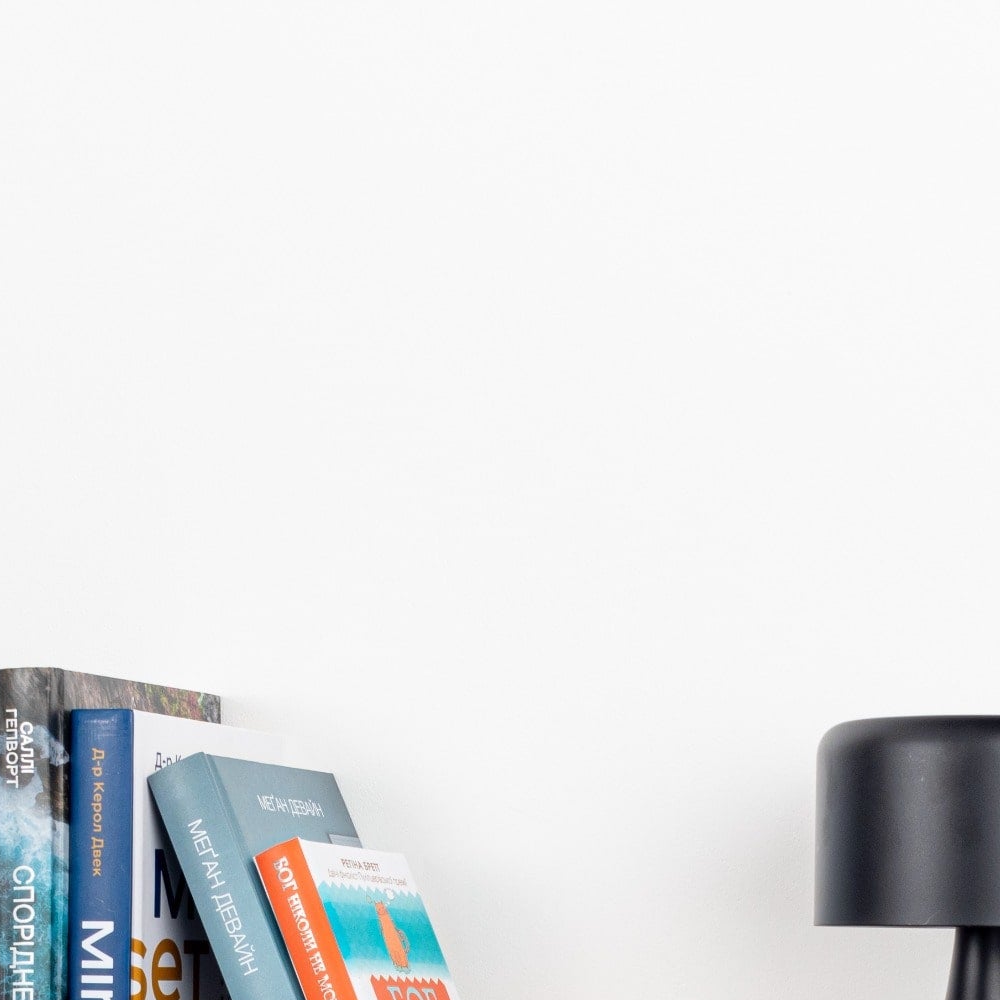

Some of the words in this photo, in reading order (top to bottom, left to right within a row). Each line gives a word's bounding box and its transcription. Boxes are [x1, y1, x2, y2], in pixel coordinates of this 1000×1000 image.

[5, 708, 18, 789] ГЕПВОРТ
[20, 721, 35, 774] САЛЛІ
[91, 748, 105, 777] Д-р
[91, 782, 105, 832] Керол
[91, 836, 104, 877] Двек
[187, 818, 226, 889] МЕҐАН
[211, 893, 259, 976] ДЕВАЙН
[273, 855, 298, 892] БОГ
[287, 892, 318, 953] НІКОЛИ
[309, 952, 326, 976] НЕ
